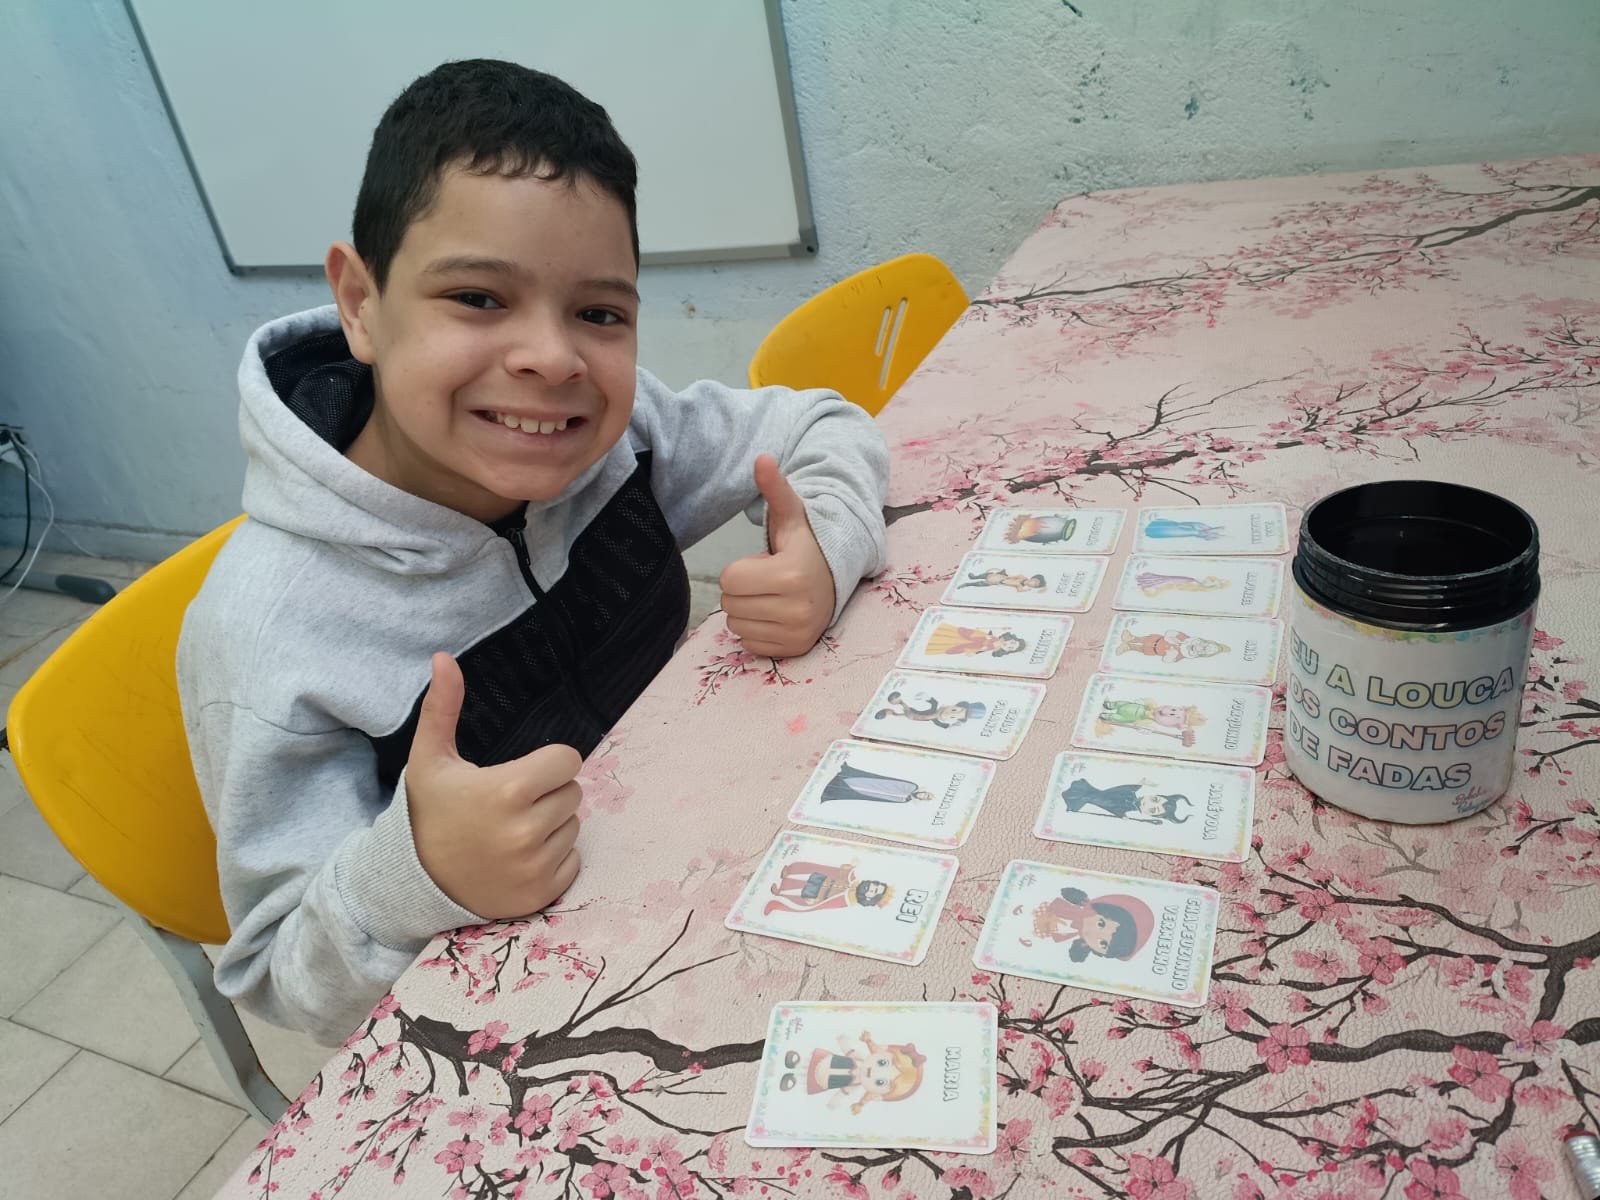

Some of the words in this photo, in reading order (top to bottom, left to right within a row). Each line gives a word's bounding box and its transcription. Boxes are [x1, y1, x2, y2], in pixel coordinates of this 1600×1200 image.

[1029, 628, 1056, 665] RAINHA
[1243, 639, 1258, 662] ANÃO
[1325, 664, 1356, 697] A
[1366, 666, 1514, 709] LOUCA
[980, 699, 1008, 738] FALANTE
[1000, 707, 1020, 734] GRILO
[1224, 697, 1247, 751] PORQUINHO
[1328, 707, 1506, 751] CONTOS
[1289, 711, 1320, 760] DE
[1327, 745, 1472, 791] FADAS
[939, 772, 966, 811] RAINHA
[1202, 781, 1226, 841] MALÉVOLA
[895, 888, 929, 924] REI
[1151, 904, 1180, 975] VERMELHO
[1170, 897, 1202, 991] CHAPEUZINHO
[942, 1046, 962, 1102] MARIA
